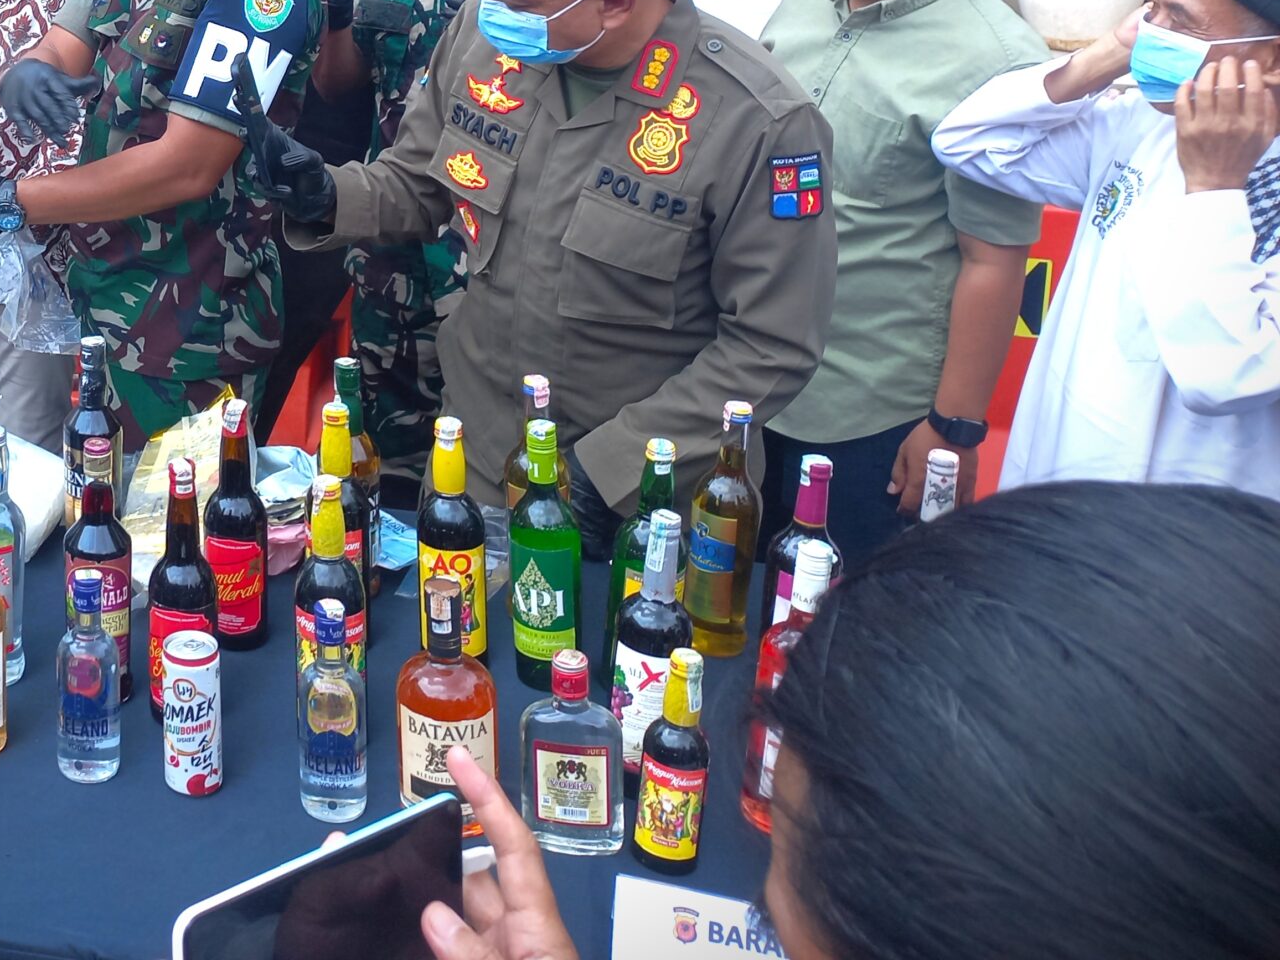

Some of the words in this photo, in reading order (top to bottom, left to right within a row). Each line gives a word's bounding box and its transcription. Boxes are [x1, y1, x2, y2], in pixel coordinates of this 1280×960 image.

[450, 102, 518, 155] SYACH
[595, 165, 641, 207] POL
[649, 192, 689, 220] PP
[433, 552, 473, 576] AO
[408, 715, 488, 742] BATAVIA
